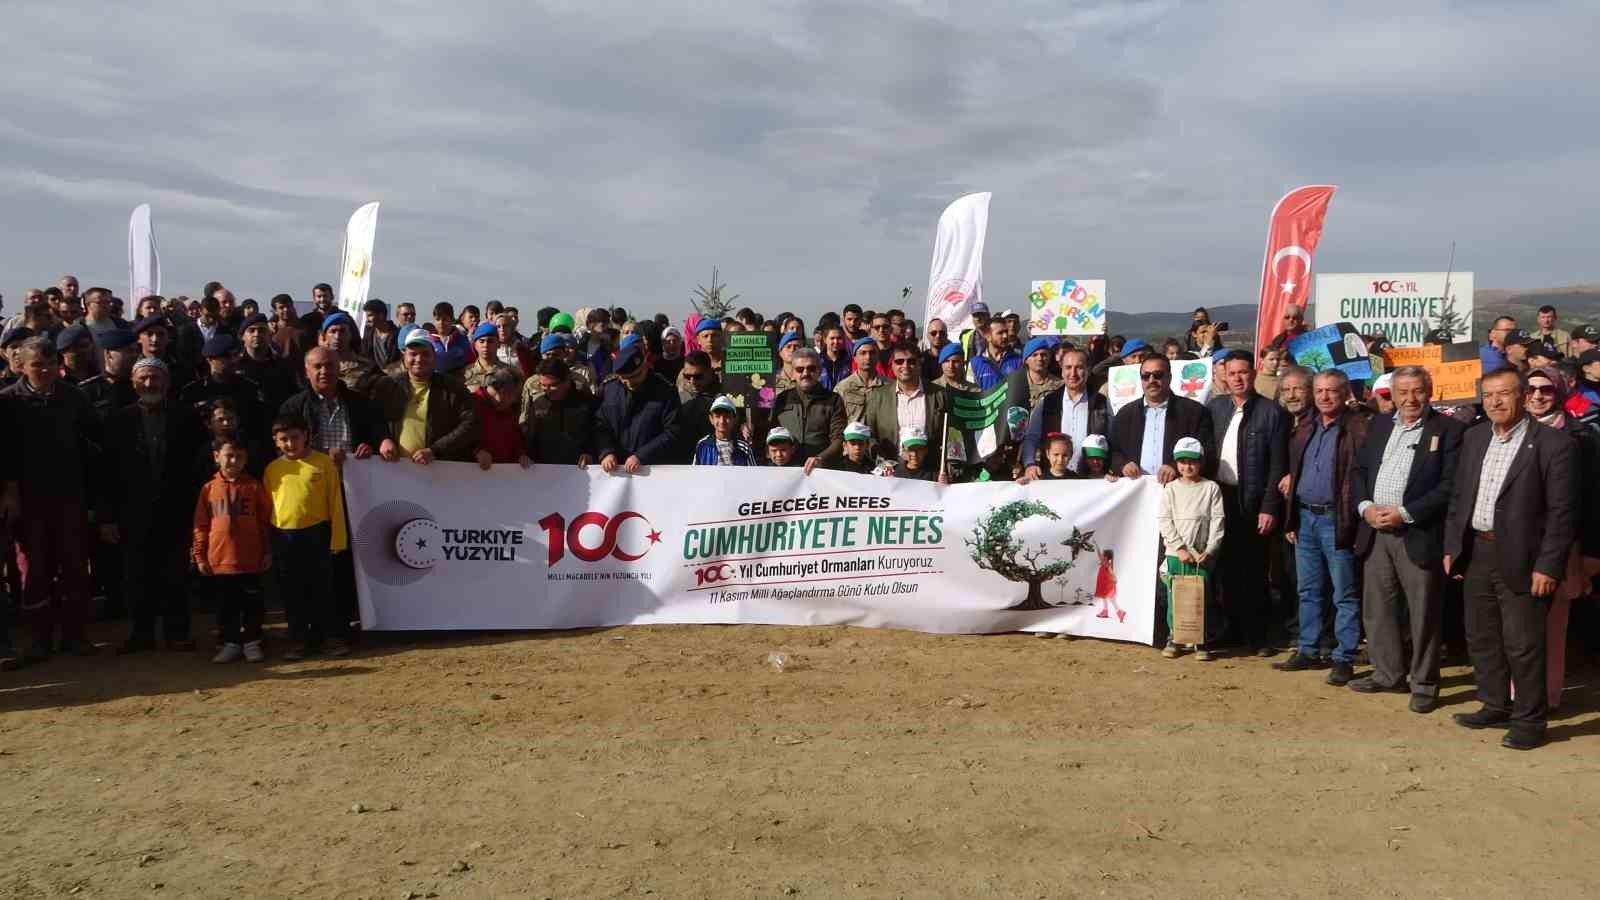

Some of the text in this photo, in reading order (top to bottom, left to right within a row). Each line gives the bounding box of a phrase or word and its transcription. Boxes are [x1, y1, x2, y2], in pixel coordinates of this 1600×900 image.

[738, 494, 891, 516] GELECEĞE NEFES
[867, 516, 943, 545] NEFES
[756, 561, 818, 578] Cumhuriyet
[821, 556, 875, 574] Ormanları
[878, 555, 933, 571] Kuruyoruz
[710, 582, 919, 604] 11 Kasım Milli Ağaçlandırma Günü Kutlu Olsun
